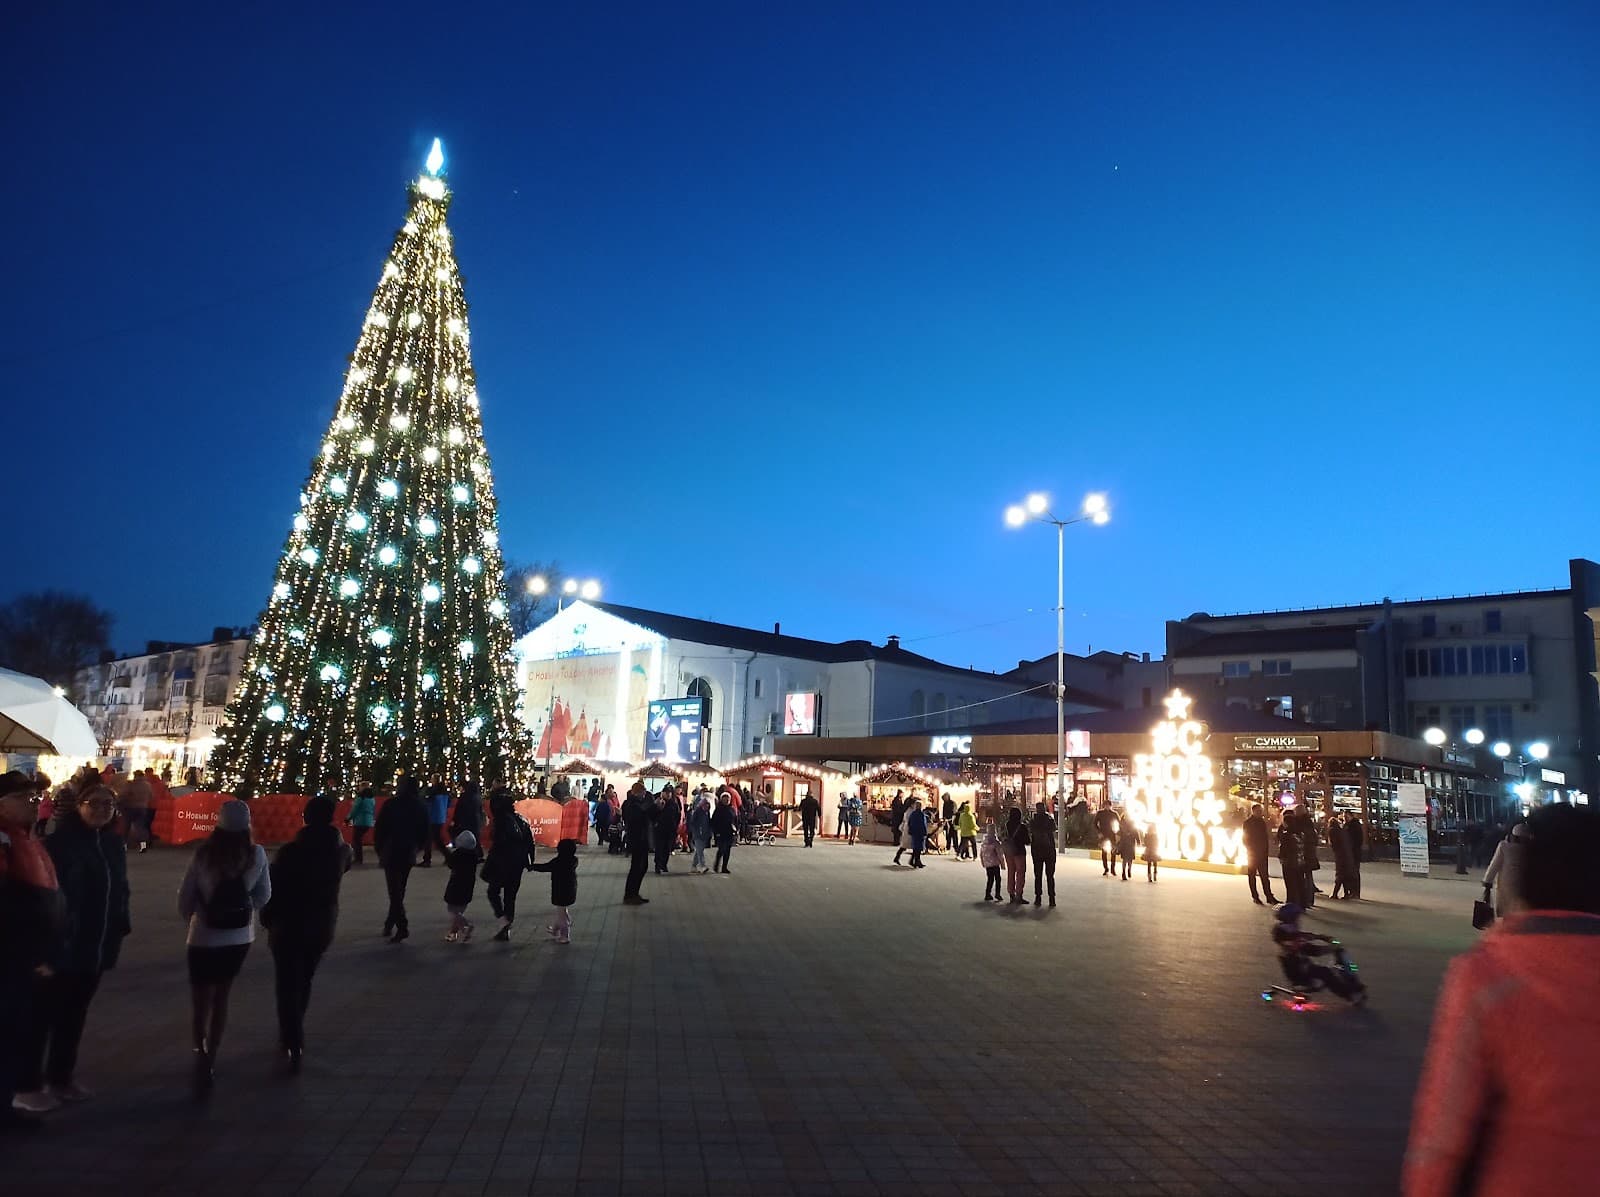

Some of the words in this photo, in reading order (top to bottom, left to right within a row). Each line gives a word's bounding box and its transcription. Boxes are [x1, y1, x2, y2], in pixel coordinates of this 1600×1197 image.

[930, 736, 972, 754] KFC
[1255, 737, 1296, 746] СУМКИ
[1133, 754, 1214, 792] НОВ
[178, 811, 184, 819] С
[185, 811, 209, 820] Новым
